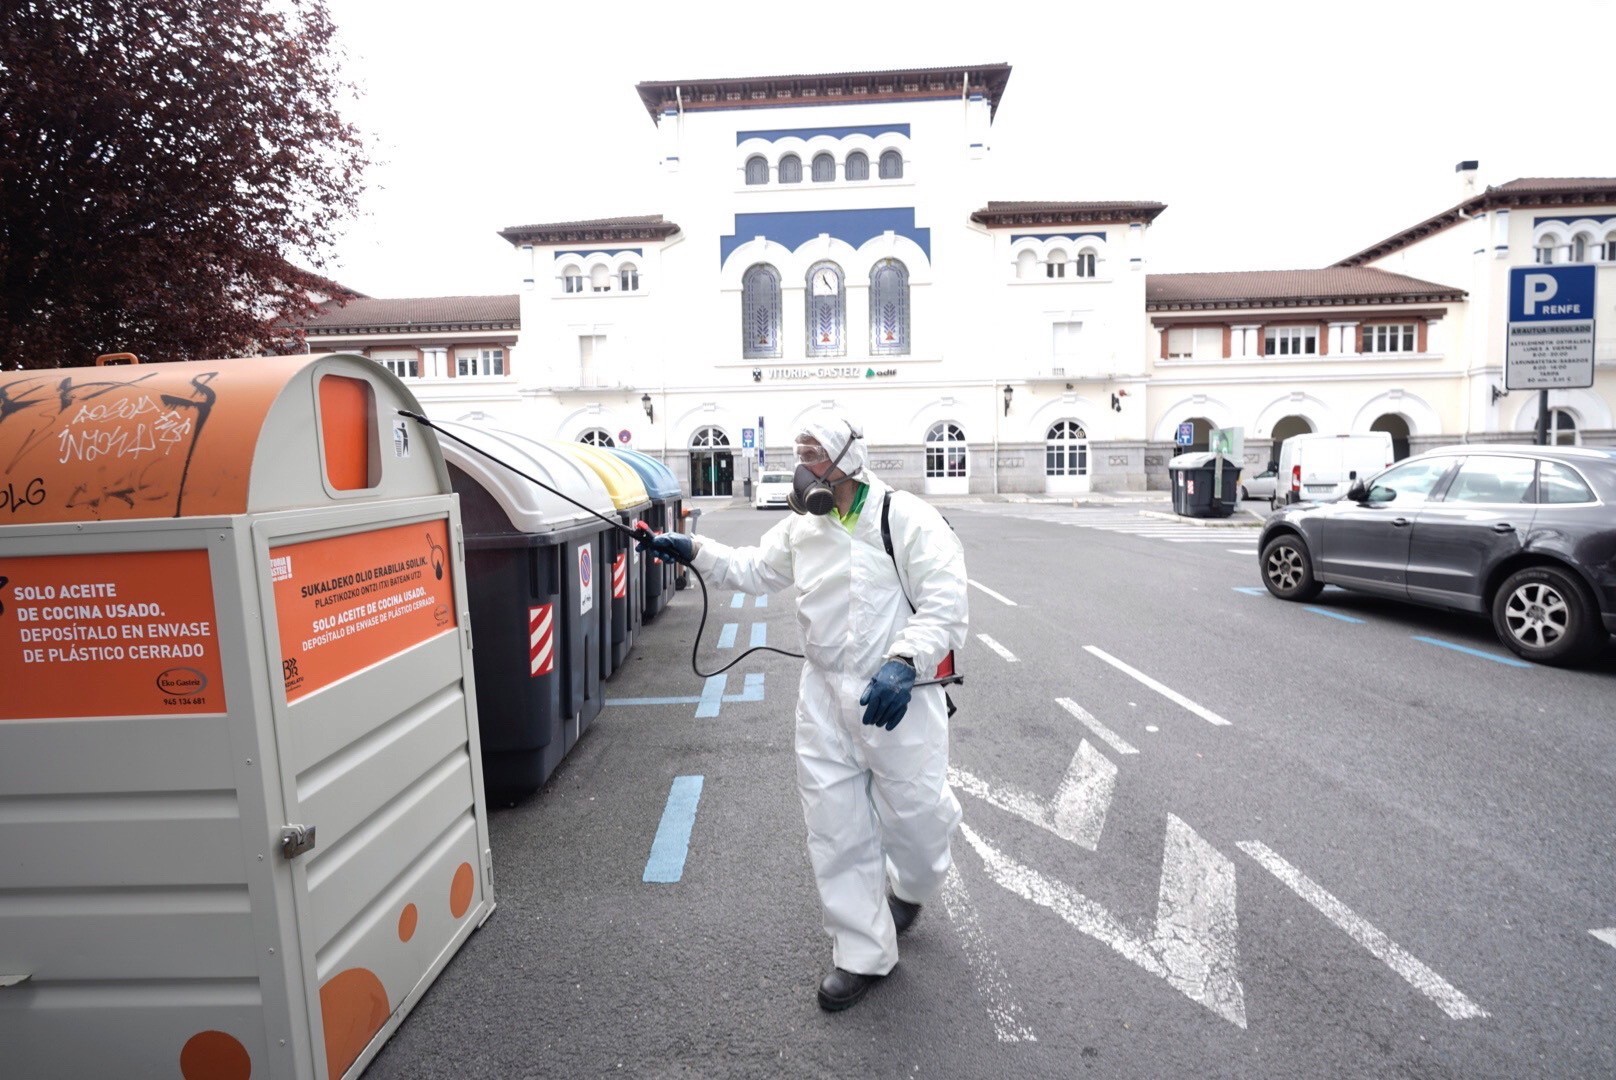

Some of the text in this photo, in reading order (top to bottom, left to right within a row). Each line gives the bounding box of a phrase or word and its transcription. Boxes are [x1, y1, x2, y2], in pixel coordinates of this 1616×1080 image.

[1523, 274, 1580, 315] P RENFE
[876, 368, 897, 377] adif
[301, 574, 354, 598] SUKALDEKO
[355, 570, 372, 583] OLIO
[374, 561, 405, 579] ERABILIA
[406, 556, 428, 570] SOILIK.
[14, 583, 117, 601] SOLO ACEITE
[315, 570, 422, 609] PLASTIKOZKO ONTZI ITXI BATEAN UTZI
[17, 603, 165, 621] DE COCINA USADO.
[313, 586, 427, 633] SOLO ACEITE DE COCINA USADO.
[20, 622, 210, 642] DEPOSÍTALO EN ENVASE
[302, 596, 435, 652] DEPOSÍTALO EN ENVASE DE PLÁSTICO CERRADO
[23, 644, 205, 663] DE PLÁSTICO CERRADO
[176, 678, 200, 687] Gasteiz
